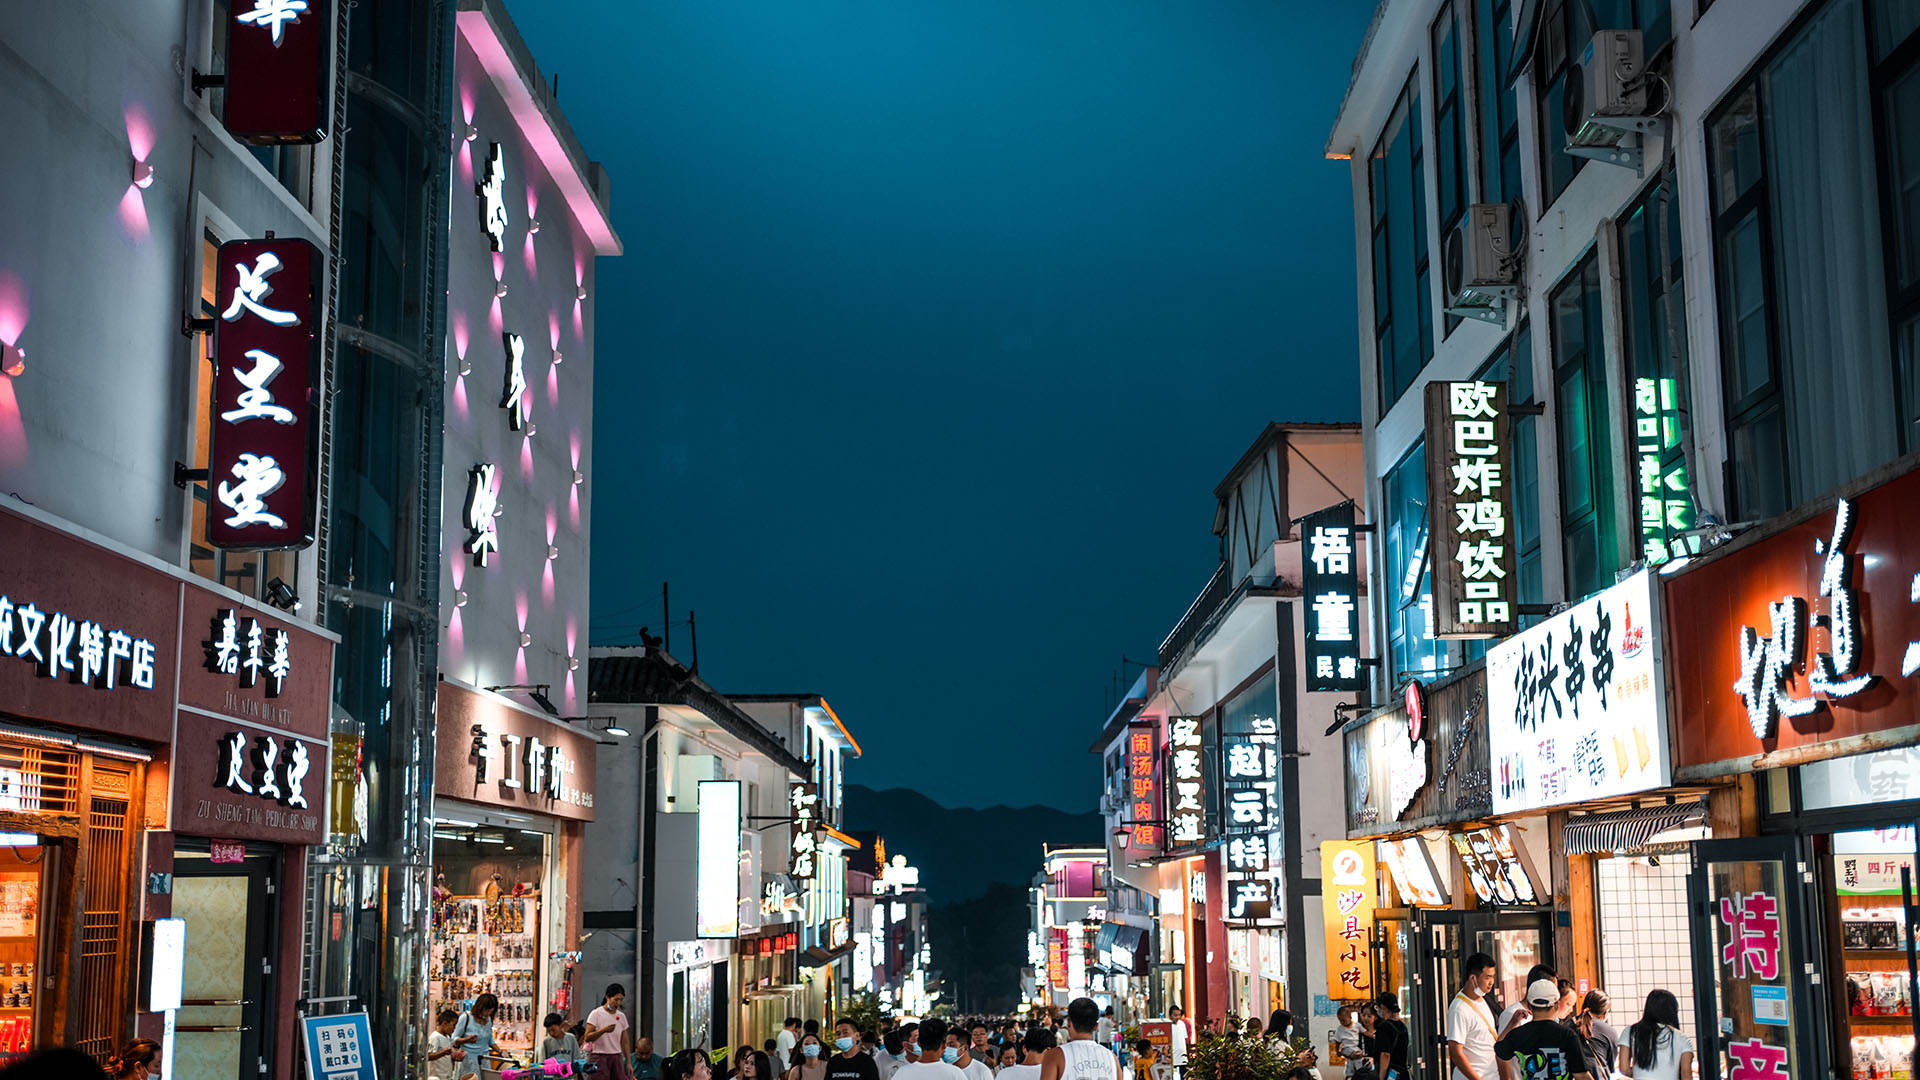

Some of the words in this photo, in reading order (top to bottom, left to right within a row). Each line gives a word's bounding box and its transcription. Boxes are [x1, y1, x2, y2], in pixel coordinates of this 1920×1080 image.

[1450, 380, 1509, 624] 欧巴炸鸡饮品
[1310, 526, 1354, 642] 梧童
[1733, 497, 1920, 739] 地道
[224, 691, 237, 711] JIA
[1316, 655, 1357, 680] 民宿
[1514, 600, 1614, 734] 街头串串
[198, 800, 210, 818] ZU
[216, 802, 242, 822] SHENG
[1131, 732, 1154, 845] 闹汤驴肉馆
[1229, 743, 1267, 917] 赵云特产
[1339, 890, 1369, 991] 沙县小吃
[322, 1028, 346, 1041] 扫码
[325, 1055, 349, 1067] 戴口罩
